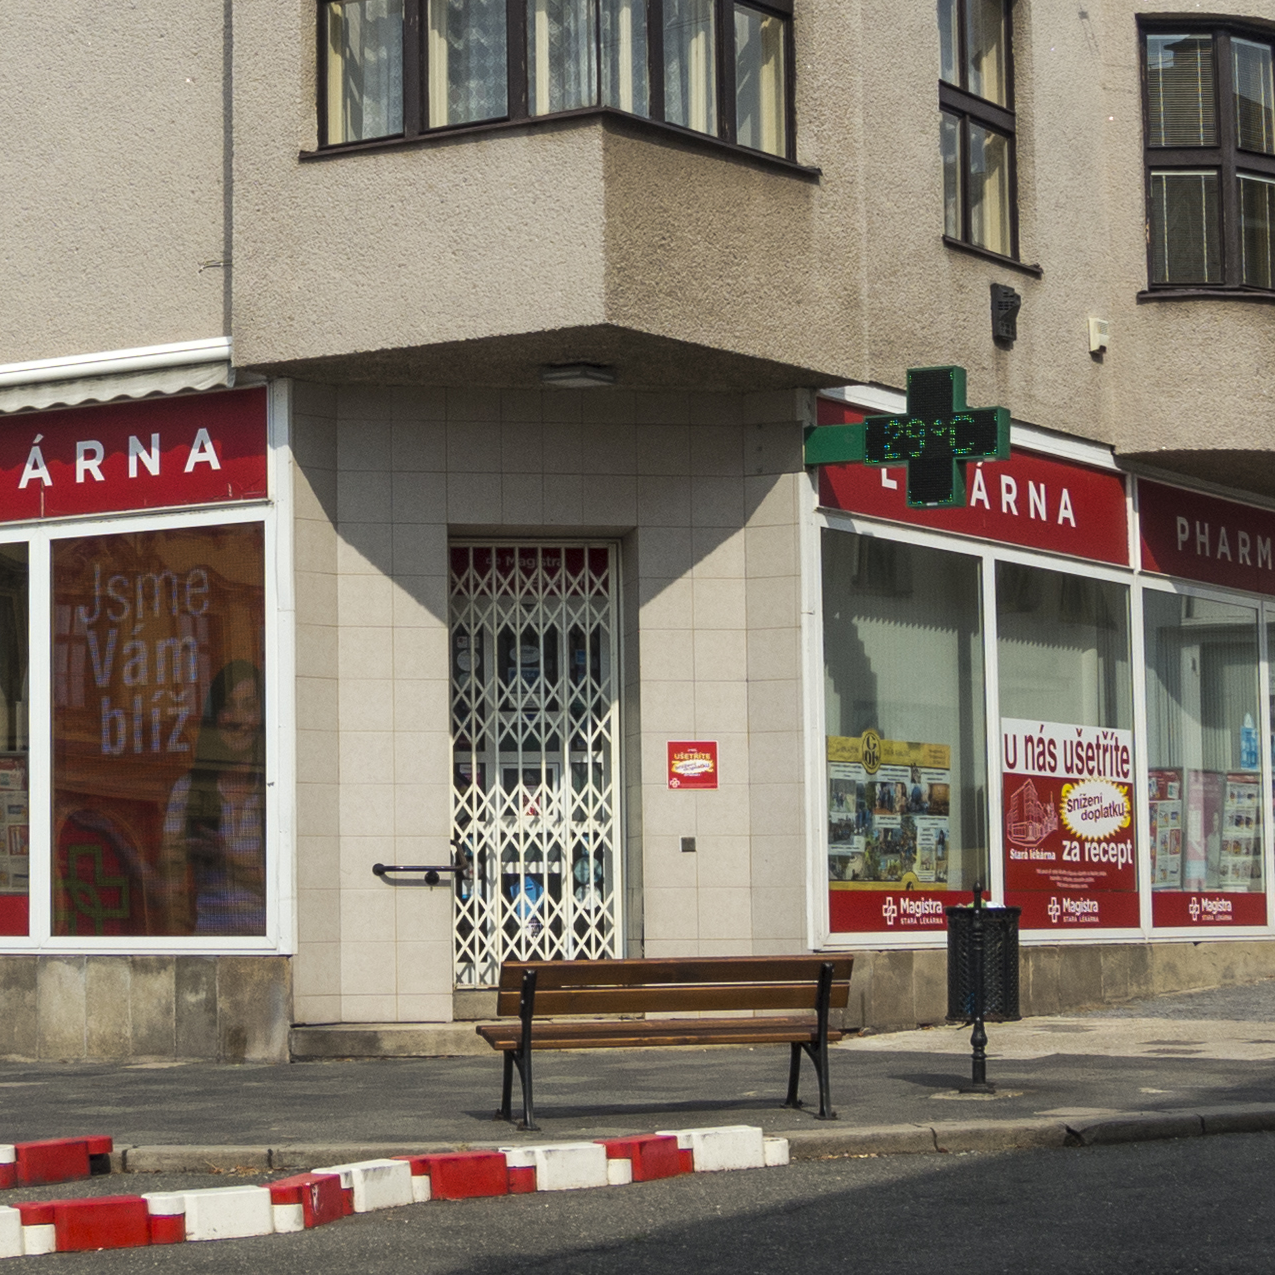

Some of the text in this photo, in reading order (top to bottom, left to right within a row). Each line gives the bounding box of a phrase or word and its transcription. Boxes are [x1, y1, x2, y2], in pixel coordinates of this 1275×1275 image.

[881, 461, 1076, 528] LÁRNA
[78, 563, 209, 624] Jsme
[86, 623, 199, 689] Vám
[101, 689, 190, 756] blíž
[1024, 724, 1058, 773] nás
[1063, 727, 1130, 779] ušetříte
[1080, 800, 1125, 823] doplatku
[1062, 839, 1133, 870] za recept
[900, 896, 943, 917] Magistra
[1062, 897, 1099, 916] Magistra
[1201, 897, 1232, 914] Magistra
